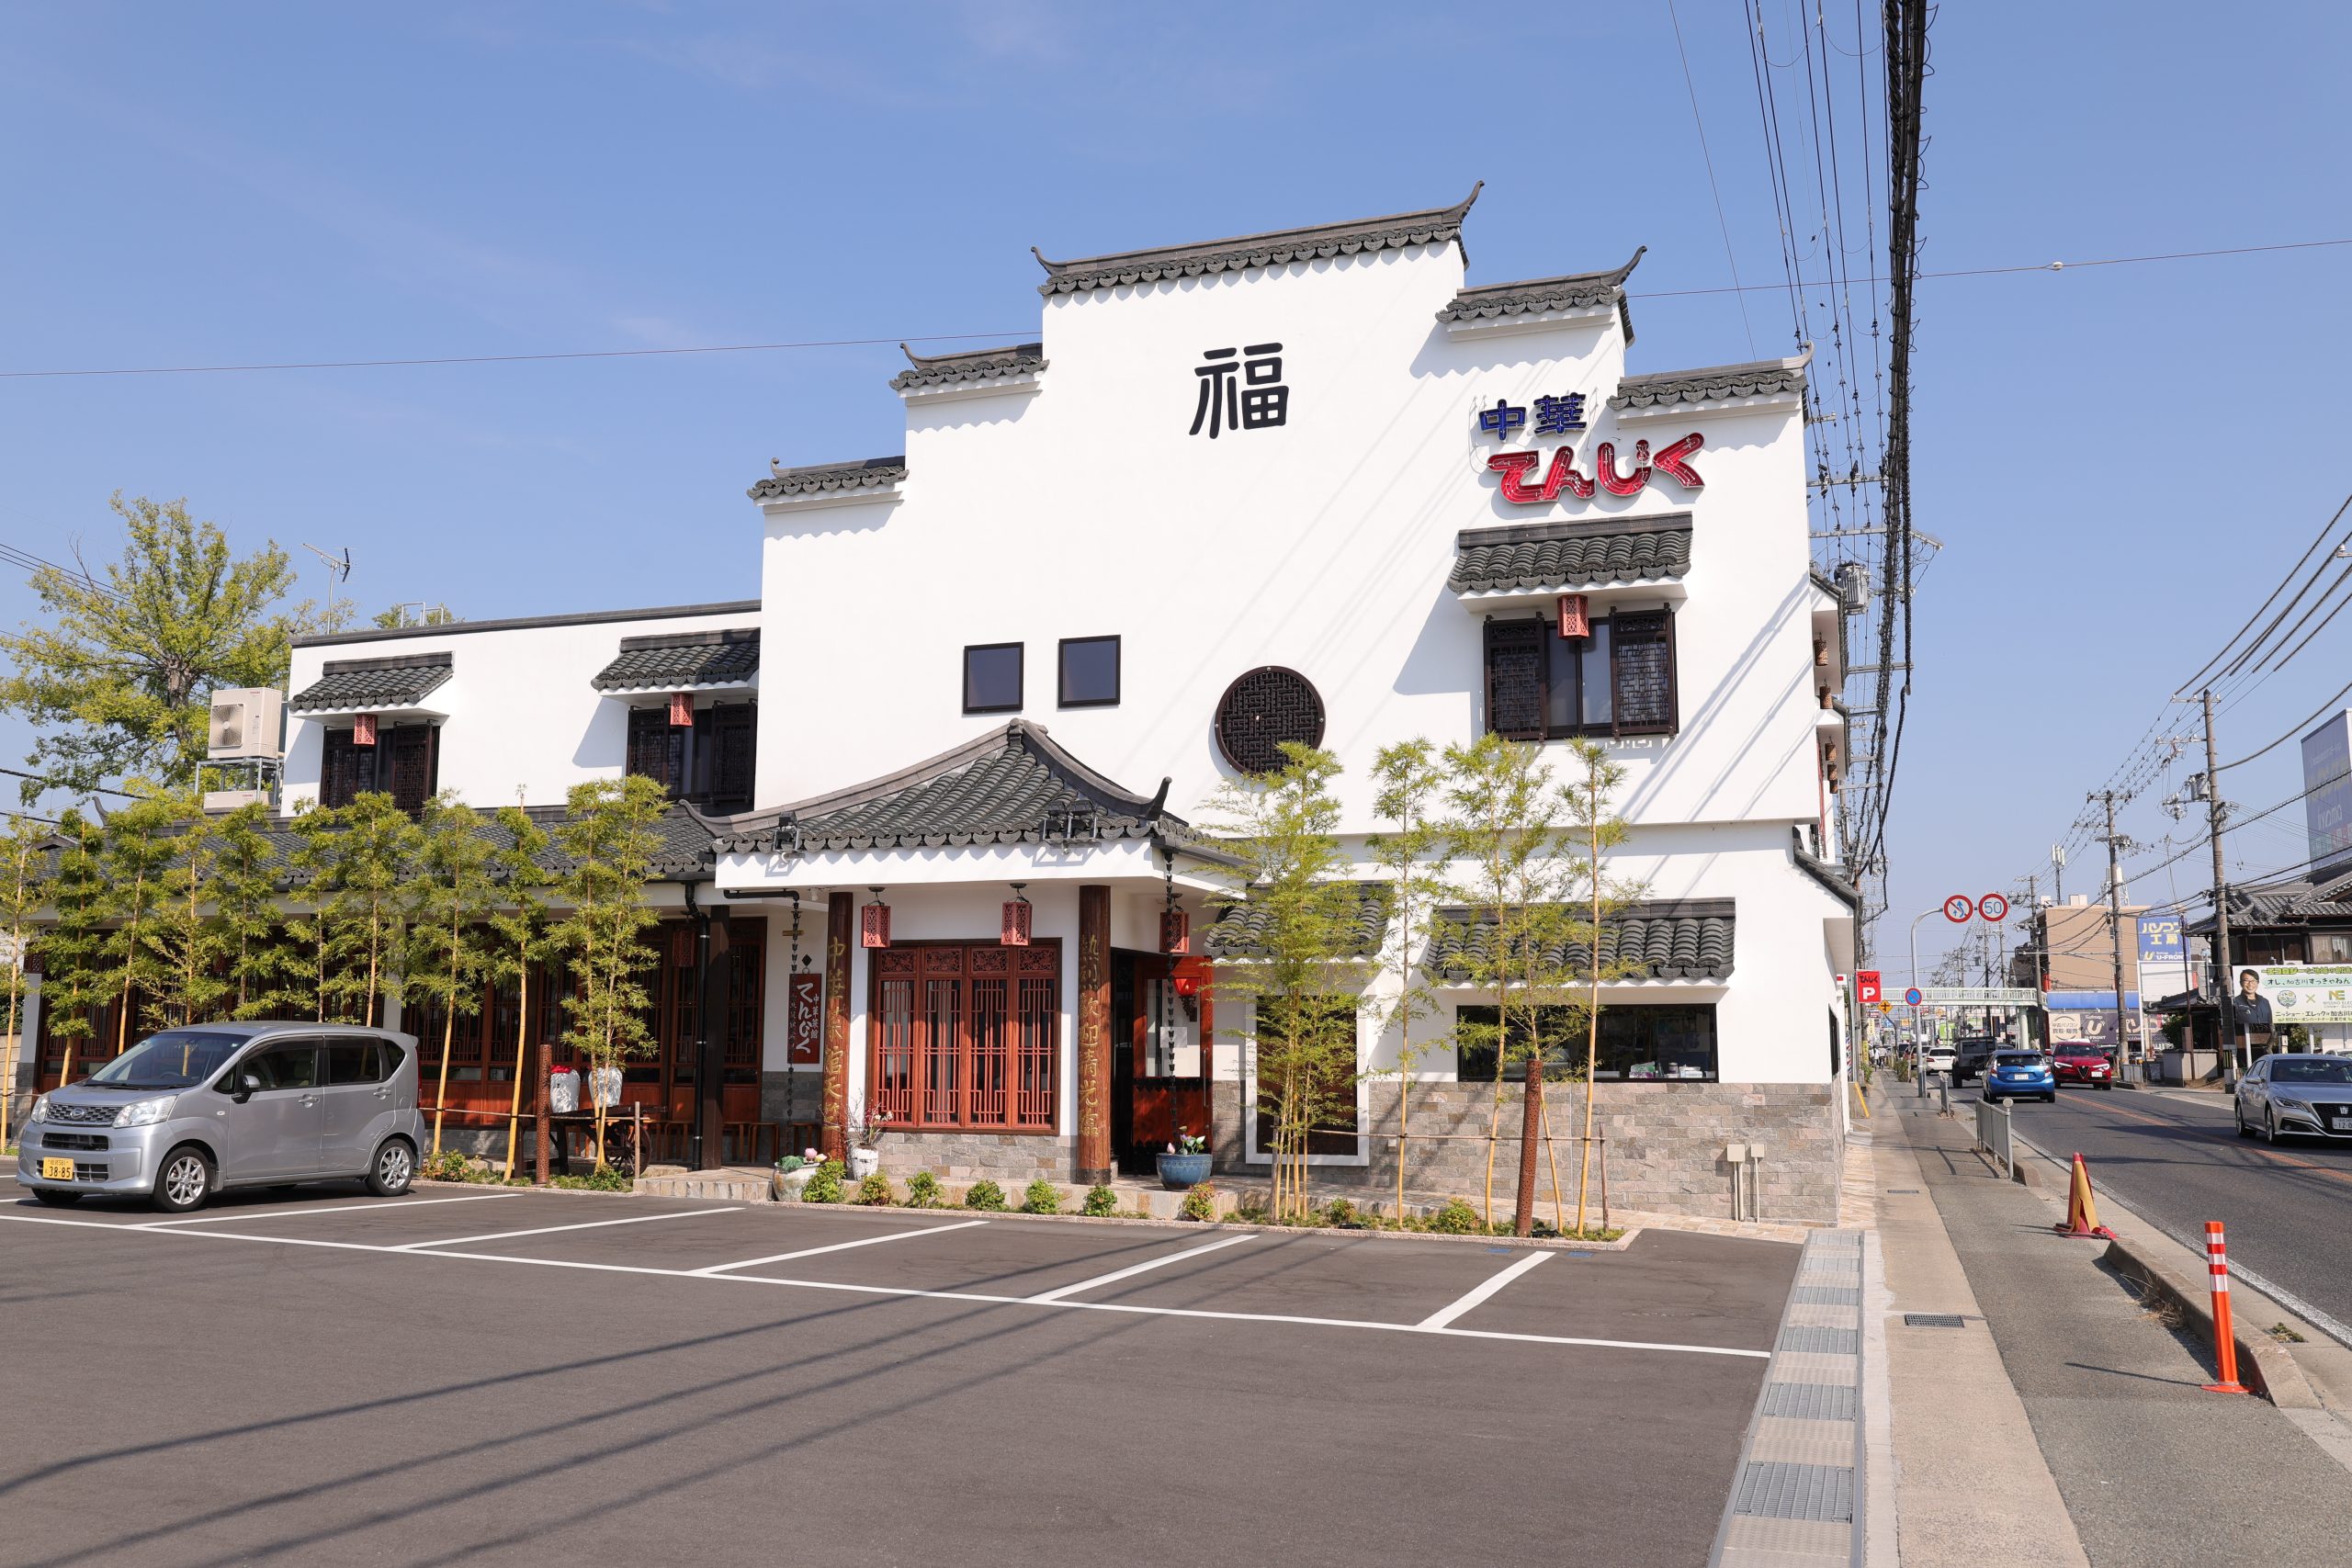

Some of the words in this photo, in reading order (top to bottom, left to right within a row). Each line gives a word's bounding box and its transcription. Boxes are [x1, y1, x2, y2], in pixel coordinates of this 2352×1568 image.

[1189, 343, 1289, 439] 福
[1479, 392, 1587, 442] 中華
[1487, 432, 1705, 504] てんじく
[1984, 901, 2002, 914] 50
[1862, 987, 1876, 999] P
[796, 982, 814, 1055] てんじく
[49, 1166, 71, 1178] 38-85
